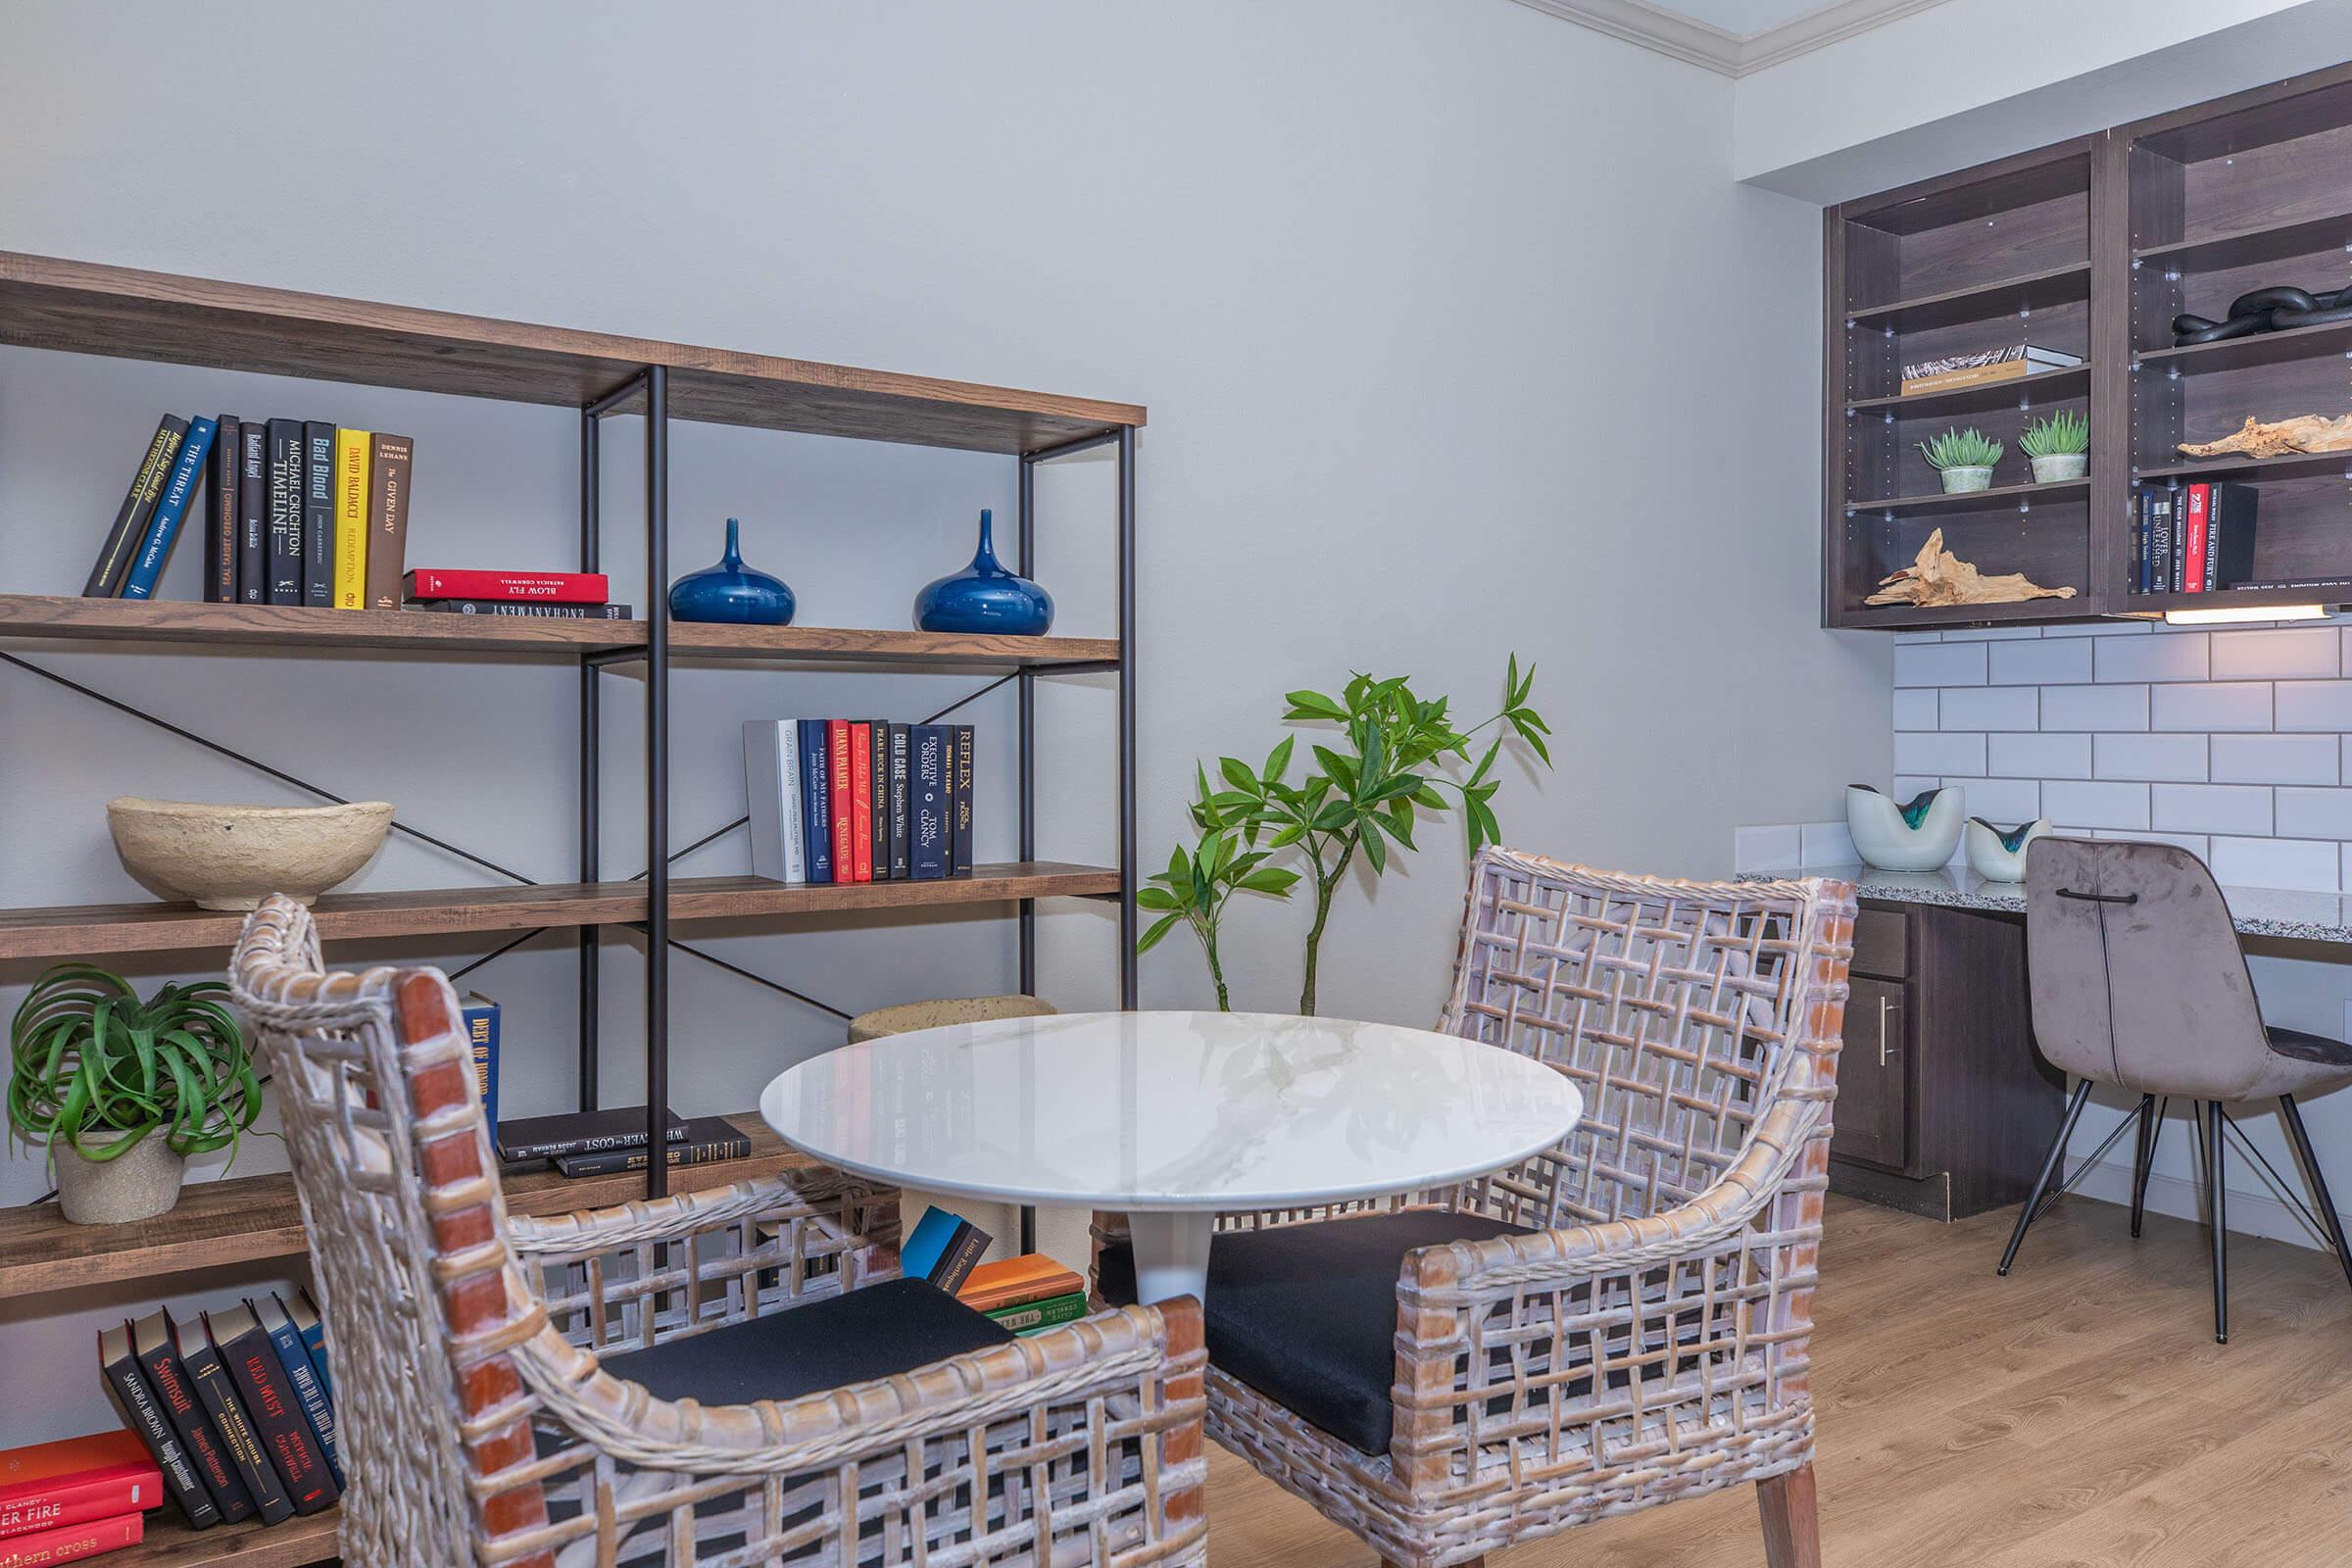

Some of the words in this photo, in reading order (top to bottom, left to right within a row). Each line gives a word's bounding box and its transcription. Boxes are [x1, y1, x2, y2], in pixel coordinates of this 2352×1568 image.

[184, 444, 201, 466] THE
[247, 434, 262, 460] Radiant
[313, 438, 329, 462] Bad
[347, 447, 361, 472] DAVID
[379, 452, 409, 462] LEHANE
[381, 444, 408, 453] DENNIS
[245, 459, 262, 479] Angel
[289, 440, 301, 489] MICHAEL
[170, 466, 192, 507] THREAT
[272, 460, 287, 534] TIMELINE
[313, 466, 329, 500] Blood
[347, 476, 361, 518] BALDACCI
[386, 480, 397, 512] GIVEN
[223, 493, 232, 536] GERONIMO
[289, 492, 301, 557] CRICHTON
[384, 511, 396, 534] DAY
[222, 538, 231, 566] TARGET
[345, 527, 356, 583] REDEMPTION
[2152, 515, 2161, 567] UNLEASHED
[2160, 527, 2169, 557] LOVER
[508, 586, 525, 595] FLY
[527, 587, 557, 596] BLOW
[492, 605, 585, 619] ENCHANTMENT
[836, 729, 848, 755] DIANA
[894, 733, 906, 756] COLD
[820, 769, 825, 779] OF
[837, 757, 848, 790] PALMER
[894, 758, 906, 780] CASE
[921, 742, 930, 780] ORDERS
[929, 736, 938, 787] EXECUTIVE
[960, 730, 970, 790] REFLEX
[878, 774, 884, 783] IN
[894, 783, 905, 813] Stephen
[837, 817, 849, 861] RENEGADE
[896, 814, 905, 838] White
[920, 808, 930, 848] CLANCY
[472, 1018, 489, 1043] DEBT
[472, 1047, 489, 1059] OF
[584, 1137, 615, 1151] COST
[963, 1238, 979, 1257] Little
[942, 1258, 967, 1292] Earthquak
[154, 1357, 192, 1414] Swimsuit
[246, 1356, 268, 1385] RED
[260, 1384, 285, 1418] MIST
[303, 1385, 320, 1402] THE
[123, 1372, 147, 1409] SANDRA
[142, 1405, 166, 1439] BROWN
[309, 1399, 323, 1412] OF
[219, 1412, 246, 1462] CONNECTION
[225, 1396, 236, 1412] THE
[233, 1413, 248, 1439] WHITE
[245, 1438, 262, 1465] HOUSE
[161, 1440, 181, 1464] tough
[171, 1459, 195, 1492] customer
[191, 1427, 211, 1451] James
[204, 1449, 228, 1489] Patterson
[6, 1498, 41, 1510] CLANCY
[27, 1503, 61, 1521] FIRE
[55, 1538, 97, 1556] cross
